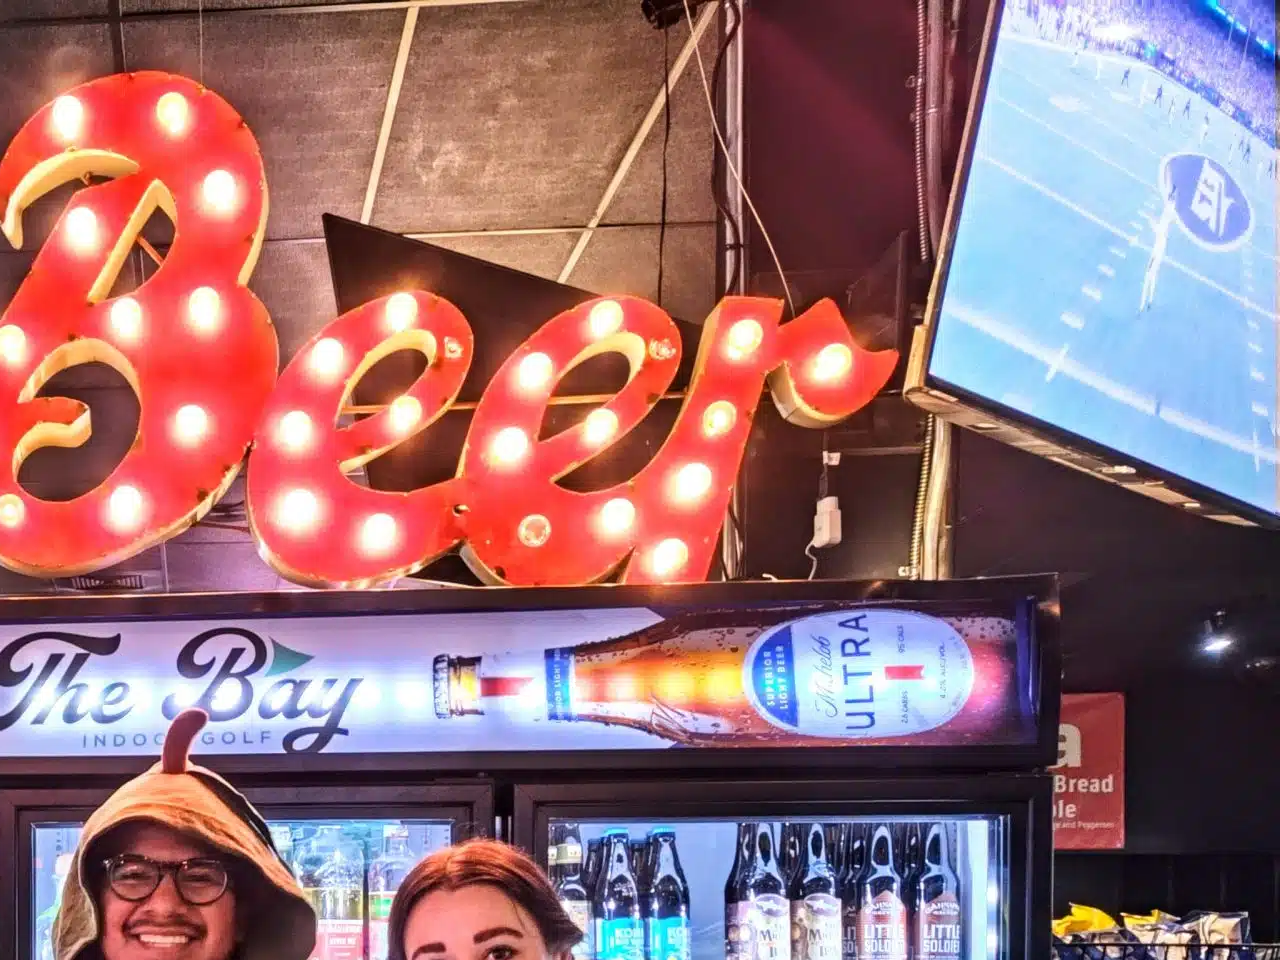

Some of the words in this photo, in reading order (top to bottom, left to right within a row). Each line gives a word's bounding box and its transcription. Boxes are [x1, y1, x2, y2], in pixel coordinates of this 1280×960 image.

[776, 645, 786, 675] BEER
[841, 613, 875, 731] ULTRA
[161, 627, 364, 753] Bay
[766, 650, 775, 707] SUPERIOR
[82, 733, 167, 749] INDOO
[201, 731, 272, 746] GOLF
[1054, 773, 1114, 793] Bread
[923, 939, 960, 953] SOLDIE
